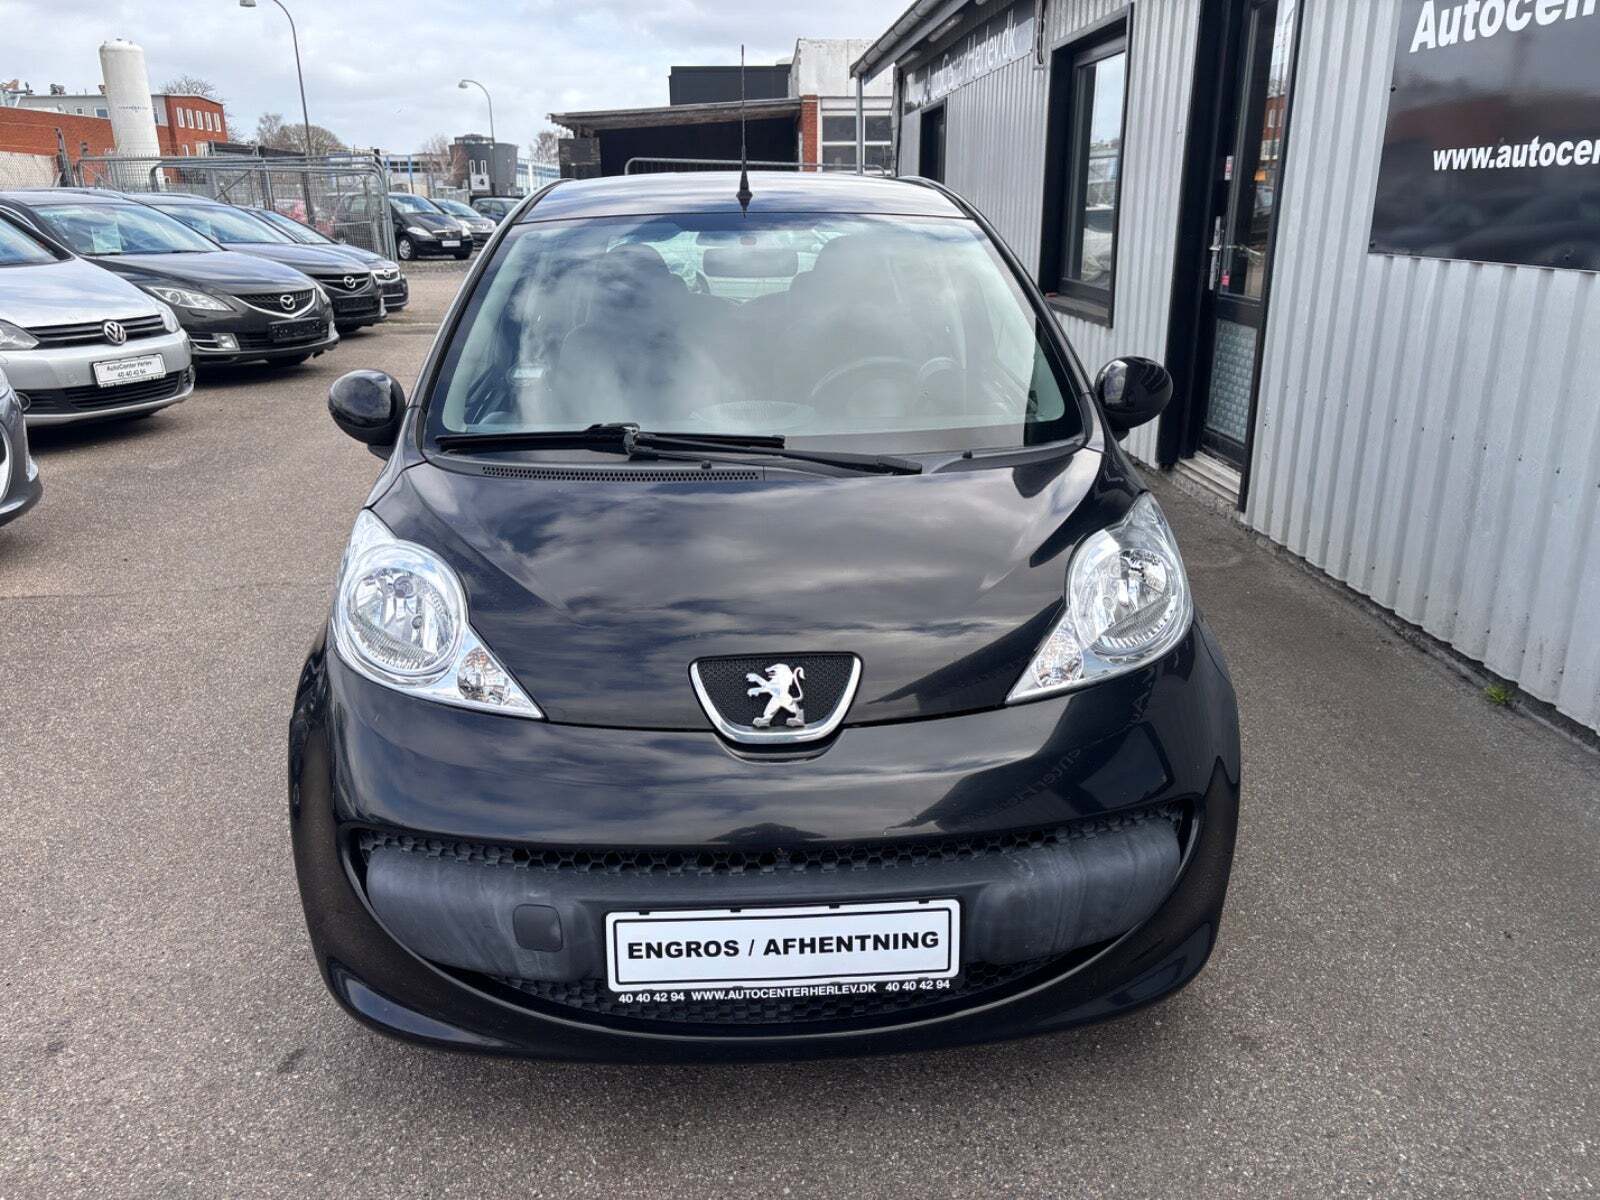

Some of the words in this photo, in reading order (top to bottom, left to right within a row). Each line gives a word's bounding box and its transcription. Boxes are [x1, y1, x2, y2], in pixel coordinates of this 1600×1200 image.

[627, 940, 740, 959] ENGROS
[748, 938, 755, 957] /
[763, 931, 939, 956] AFHENTNING
[618, 993, 633, 1003] 40
[636, 993, 651, 1003] 40
[653, 993, 668, 1002] 42
[671, 992, 685, 1001] 94
[691, 983, 877, 1001] WWW.AUTOCENTERHERLEV.DK
[885, 982, 900, 991] 40
[902, 981, 917, 991] 40
[919, 981, 934, 990] 42
[936, 979, 950, 989] 94
